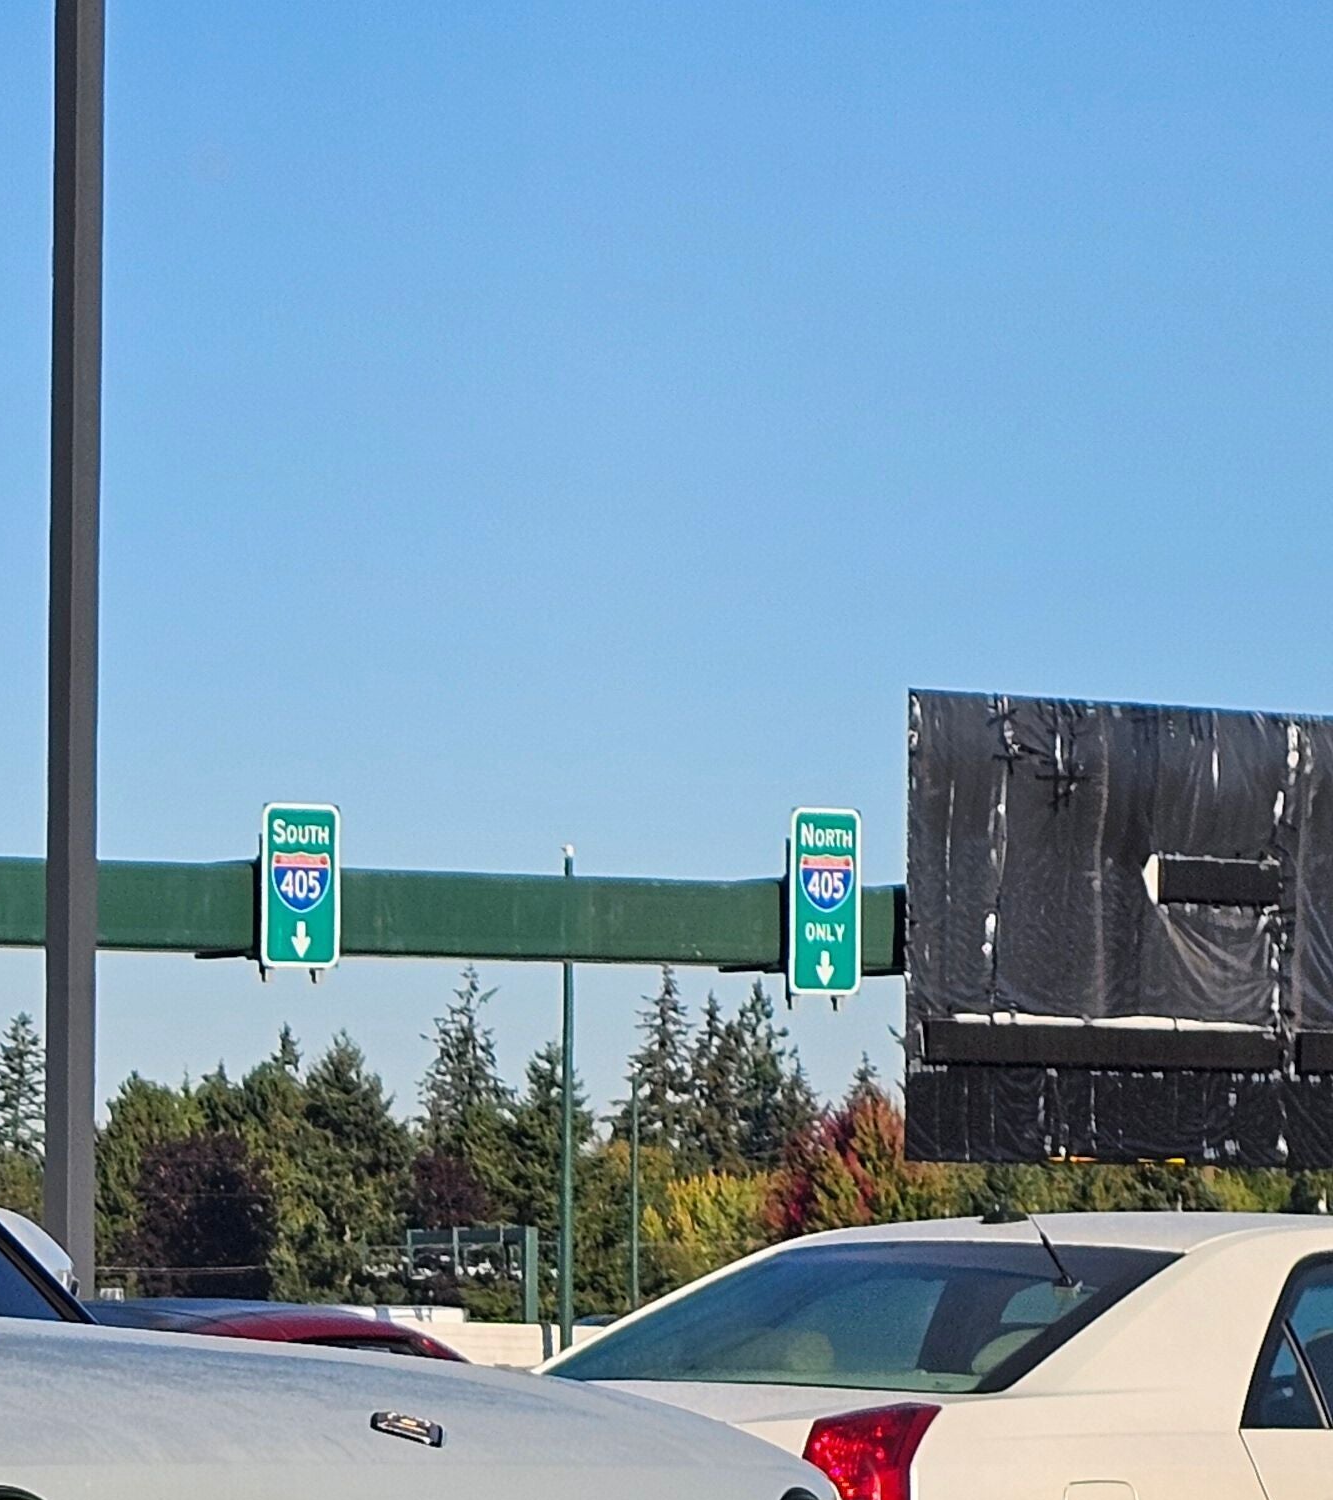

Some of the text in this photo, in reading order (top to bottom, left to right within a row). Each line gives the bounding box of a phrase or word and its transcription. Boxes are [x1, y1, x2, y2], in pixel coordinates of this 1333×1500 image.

[273, 819, 330, 845] SOUTH
[800, 822, 853, 848] NORTH
[280, 869, 321, 899] 405
[807, 871, 845, 900] 405
[805, 922, 845, 943] ONLY
